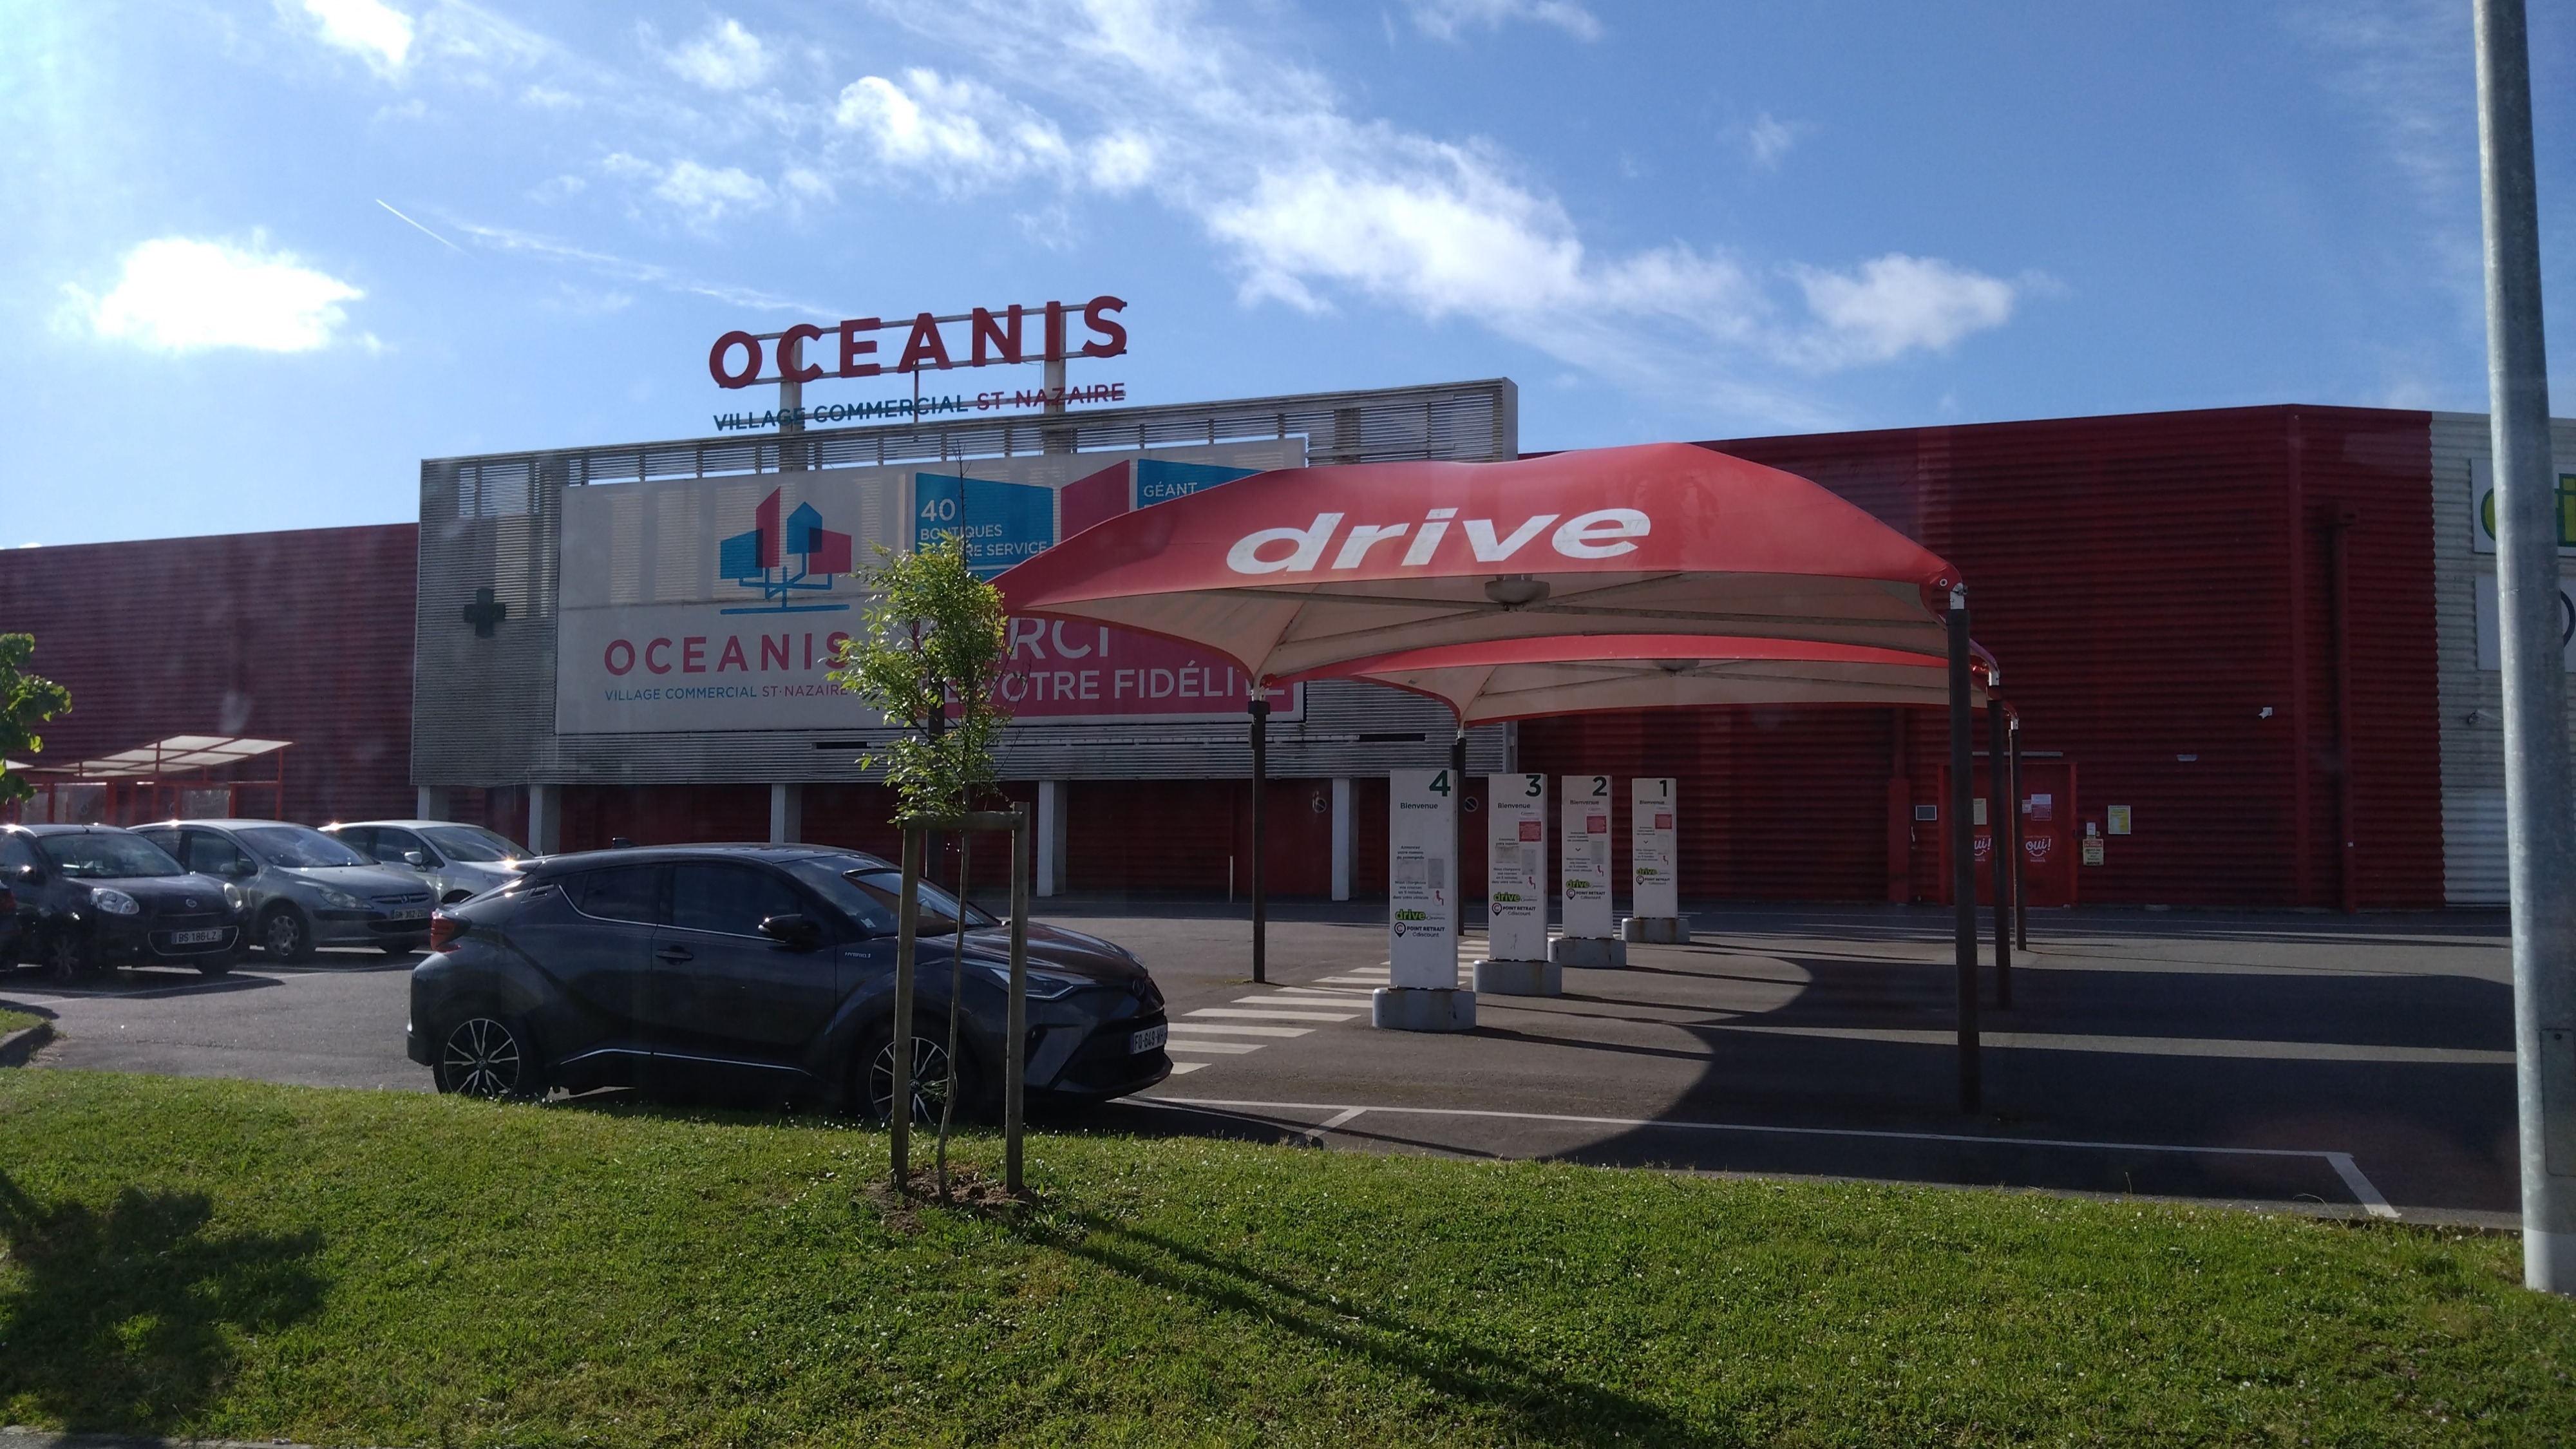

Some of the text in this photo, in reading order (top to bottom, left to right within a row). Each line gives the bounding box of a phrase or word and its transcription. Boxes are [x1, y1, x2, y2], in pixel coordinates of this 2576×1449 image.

[709, 296, 1128, 389] OCEANIS
[713, 407, 806, 431] VILLAGE
[813, 395, 969, 423] COMMERCIAL
[1143, 481, 1198, 497] GÉANT
[921, 498, 956, 522] 40
[1226, 507, 1651, 574] drive
[604, 631, 851, 676] OCEANIS
[1115, 660, 1285, 699] FIDÉLI
[604, 688, 660, 701] VILLAGE
[665, 687, 757, 699] COMMERCIAL
[1429, 770, 1450, 797] 4
[1525, 775, 1541, 797] 3
[1593, 777, 1607, 796] 2
[1660, 780, 1667, 797] 1
[1566, 879, 1590, 888] drive
[1493, 892, 1520, 902] drive
[1395, 909, 1426, 920] drive
